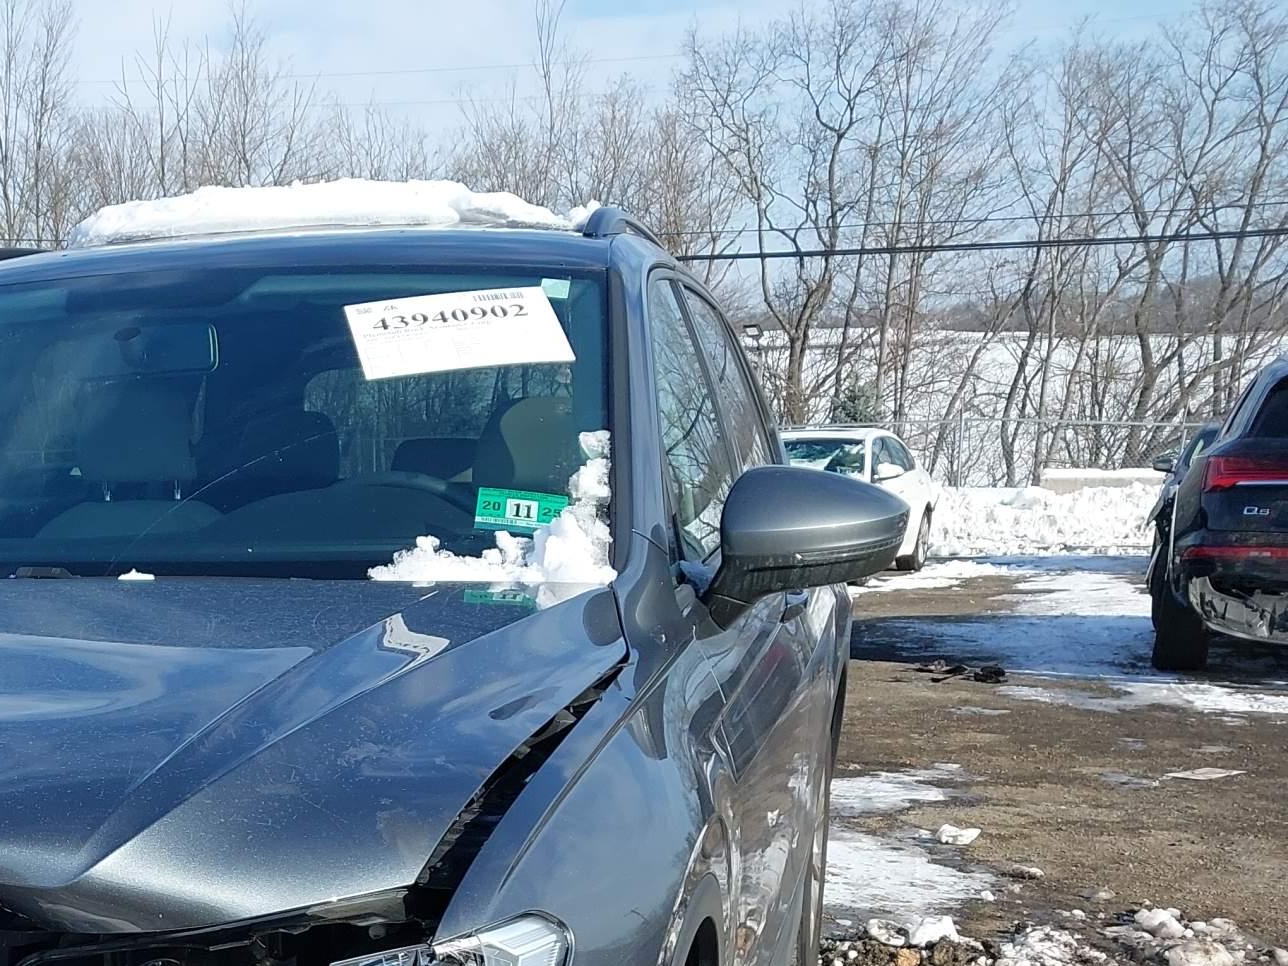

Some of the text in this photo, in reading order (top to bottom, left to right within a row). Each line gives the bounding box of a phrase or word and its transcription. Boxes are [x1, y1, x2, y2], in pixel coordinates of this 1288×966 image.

[372, 304, 529, 331] 43940902
[482, 500, 562, 519] 20 11 25
